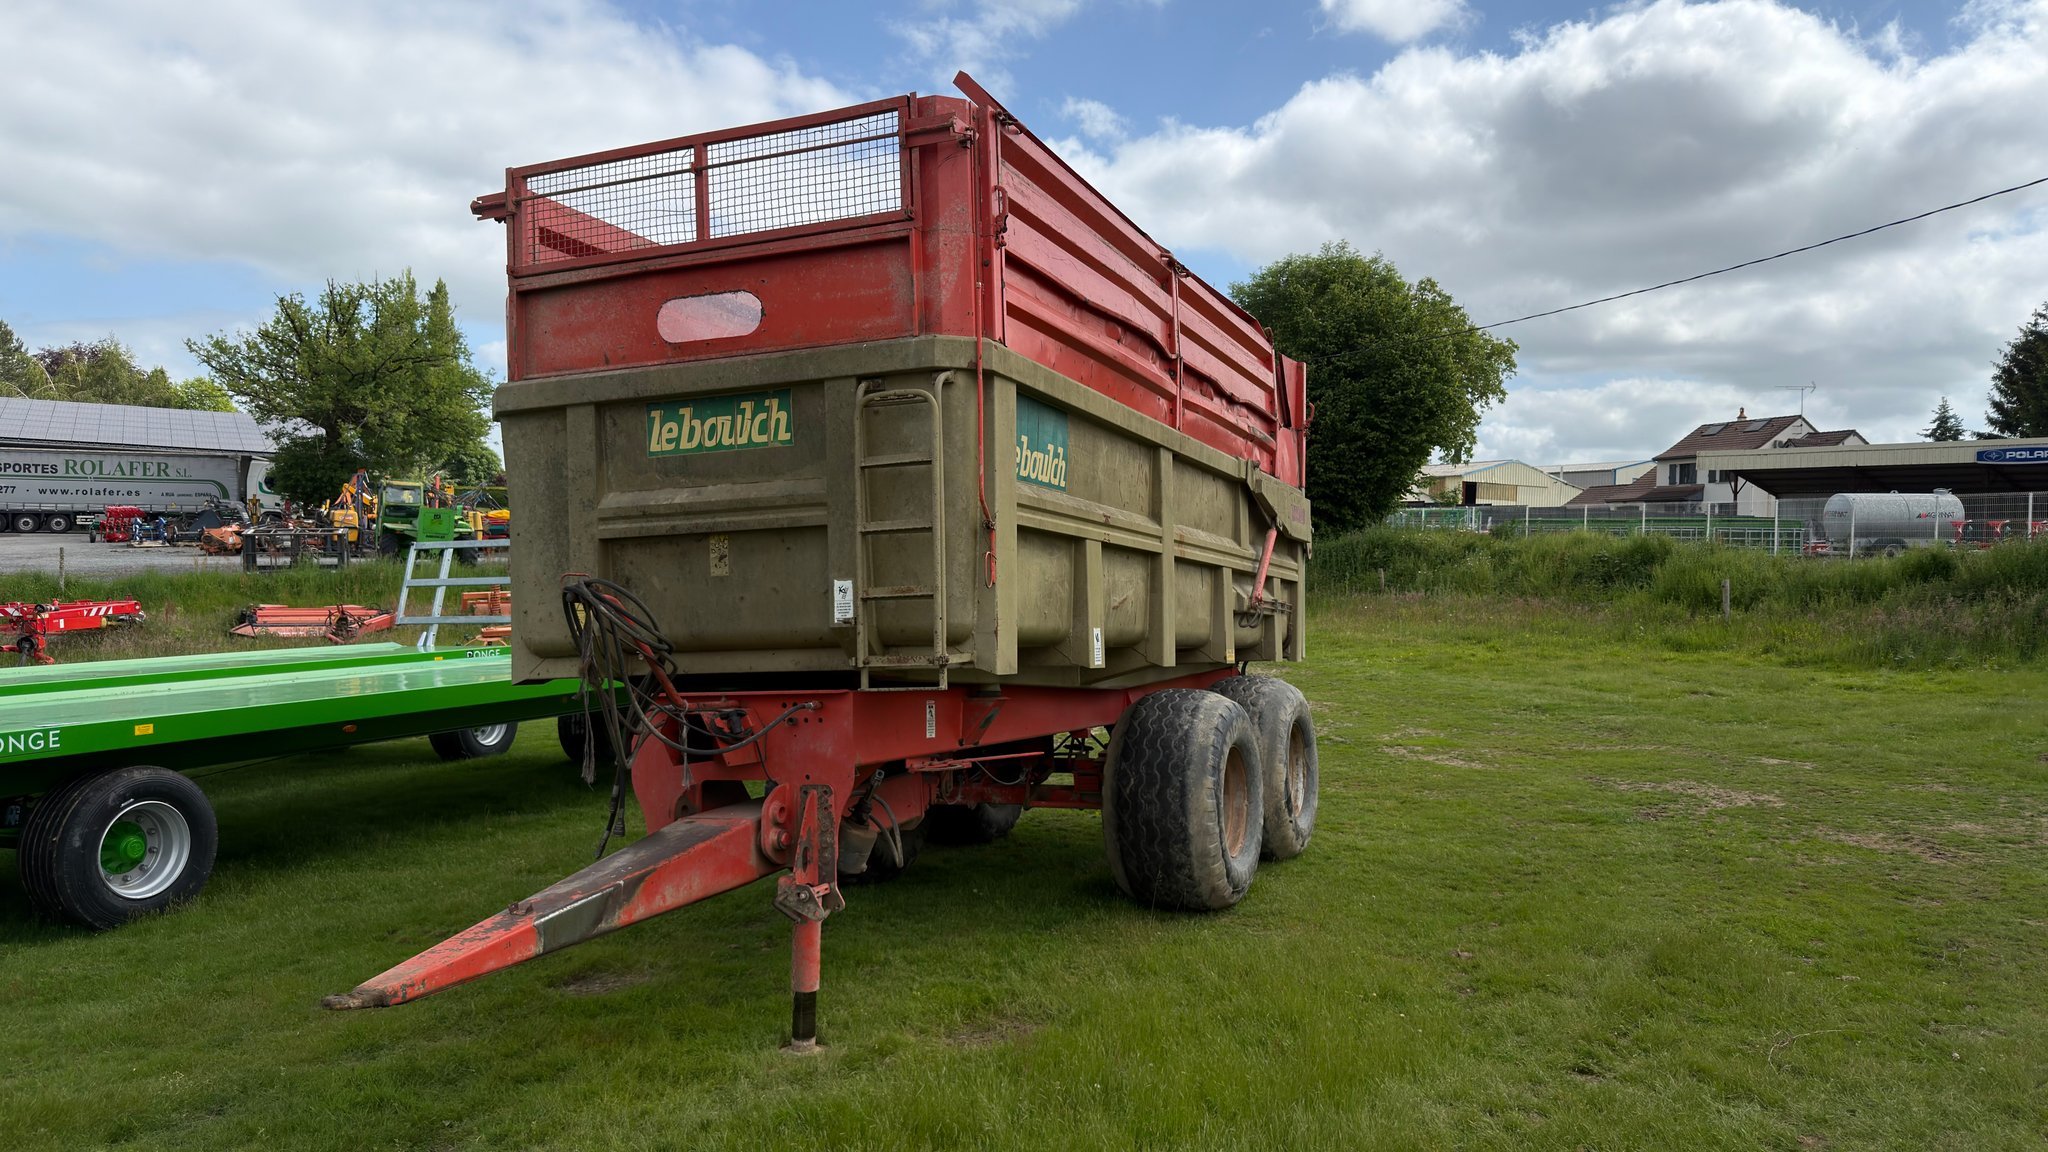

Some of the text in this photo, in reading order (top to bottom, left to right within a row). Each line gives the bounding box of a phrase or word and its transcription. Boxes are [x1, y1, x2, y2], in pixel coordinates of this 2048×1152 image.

[64, 458, 170, 478] ROLAFER
[175, 467, 192, 478] S.L.
[38, 487, 141, 497] www.rolafer.es
[0, 729, 61, 754] NGE
